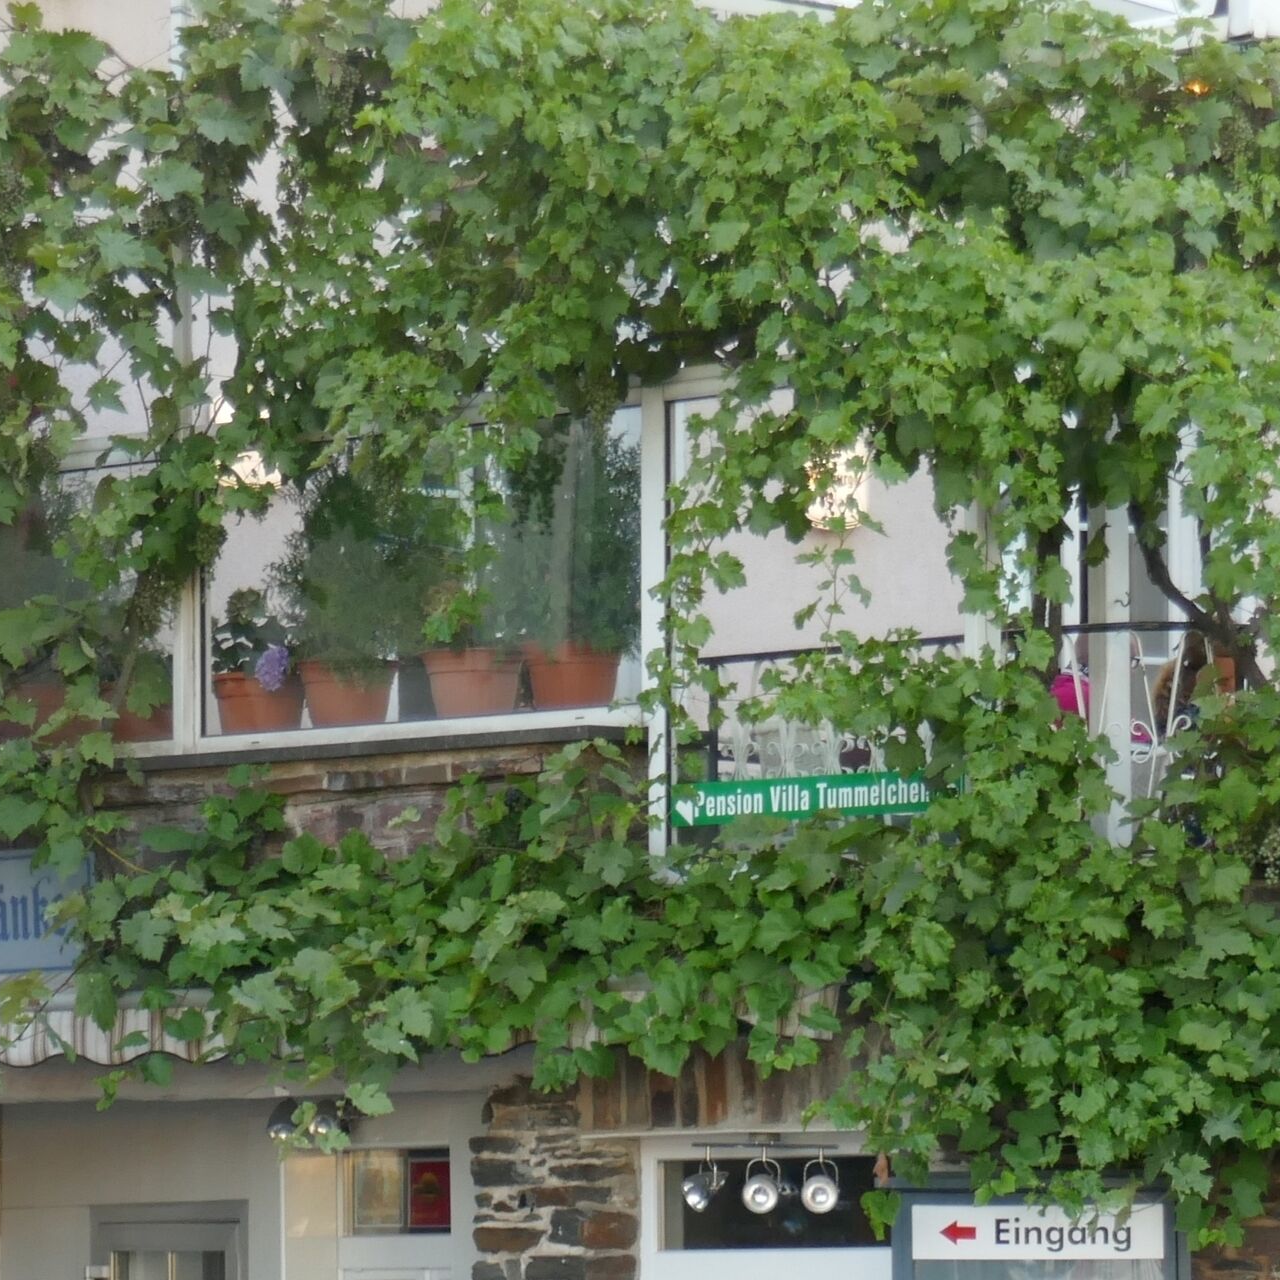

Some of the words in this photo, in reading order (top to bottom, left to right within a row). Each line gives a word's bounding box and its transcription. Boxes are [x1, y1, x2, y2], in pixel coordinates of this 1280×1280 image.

[694, 788, 763, 818] Pension
[770, 785, 810, 813] Villa
[994, 1217, 1133, 1253] Eingang
